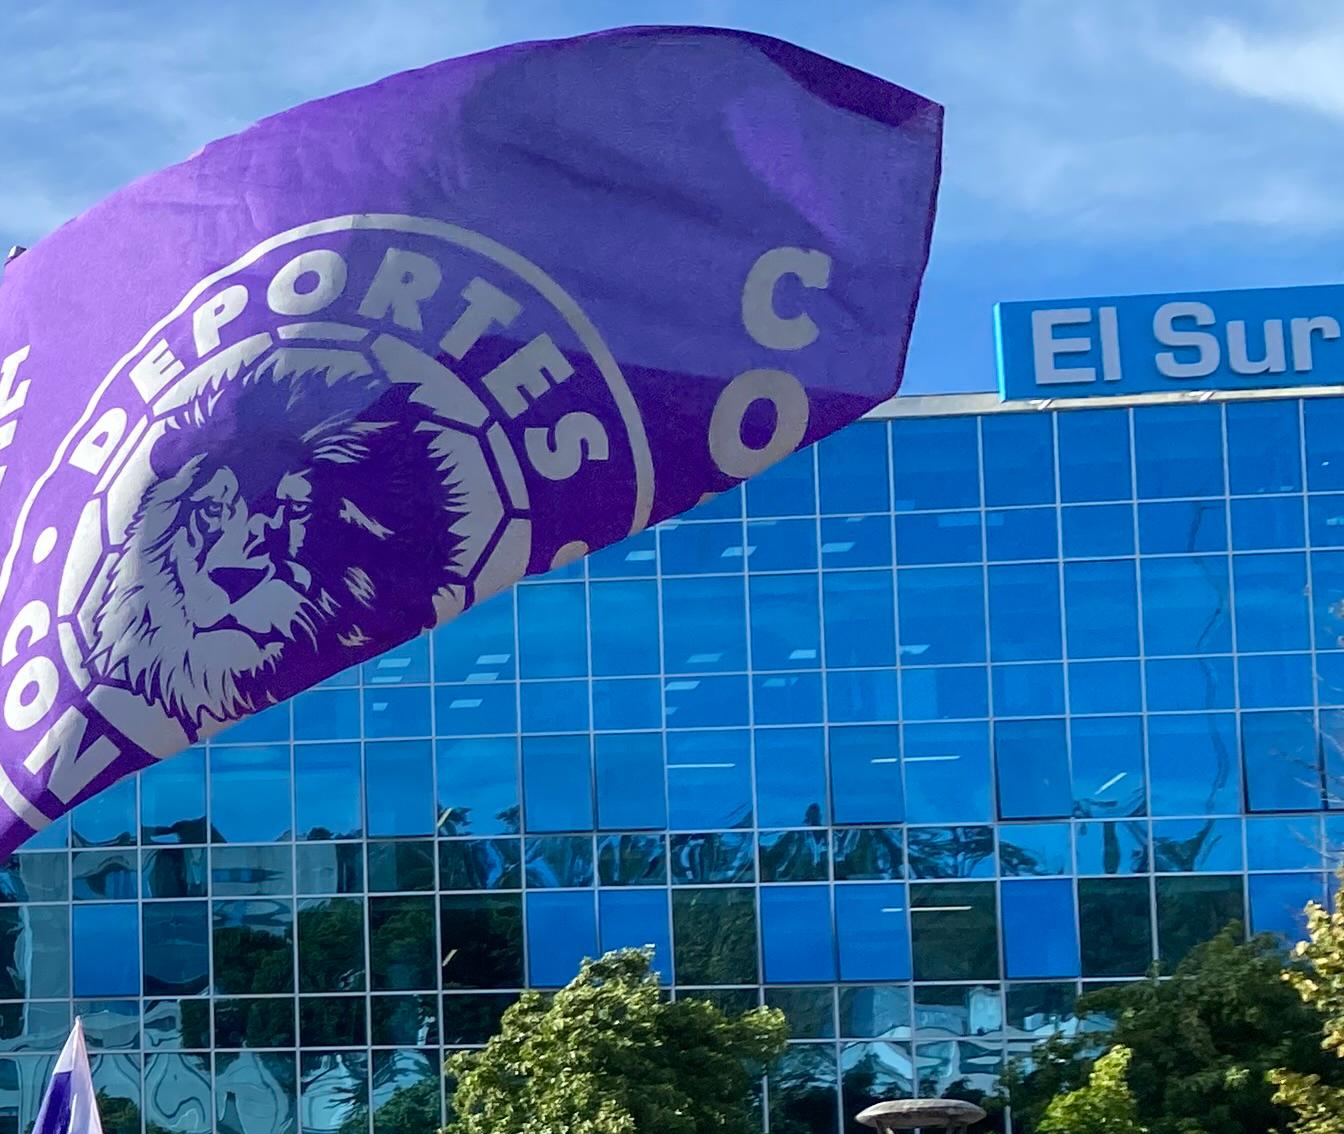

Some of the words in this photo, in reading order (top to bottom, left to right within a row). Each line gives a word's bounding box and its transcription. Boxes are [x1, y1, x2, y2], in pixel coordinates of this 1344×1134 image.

[69, 247, 609, 480] DEPORTES
[1032, 306, 1122, 385] El
[1153, 301, 1341, 379] Sur
